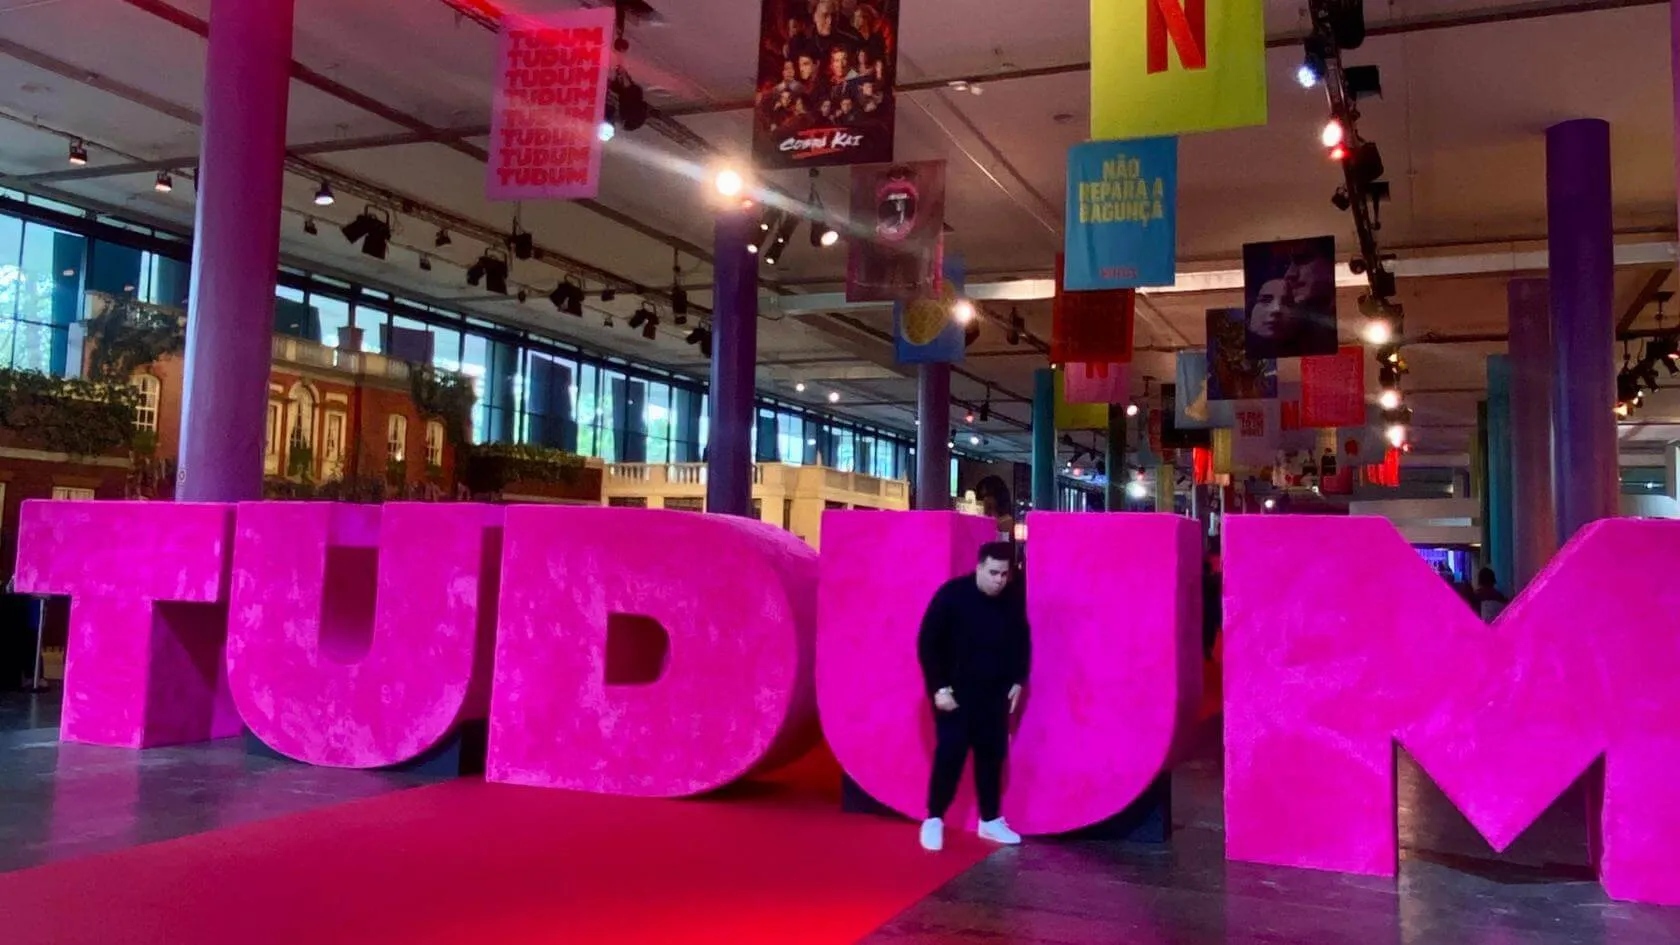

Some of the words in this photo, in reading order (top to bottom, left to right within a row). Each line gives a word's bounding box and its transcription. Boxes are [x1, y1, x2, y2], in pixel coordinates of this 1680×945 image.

[509, 27, 604, 49] TUDUM
[1146, 0, 1207, 75] N
[507, 47, 602, 69] TUDUM
[505, 67, 599, 88] TUDUM
[500, 147, 590, 168] TUDUM
[497, 167, 589, 187] TUDUM
[15, 500, 1680, 905] TUDUM
